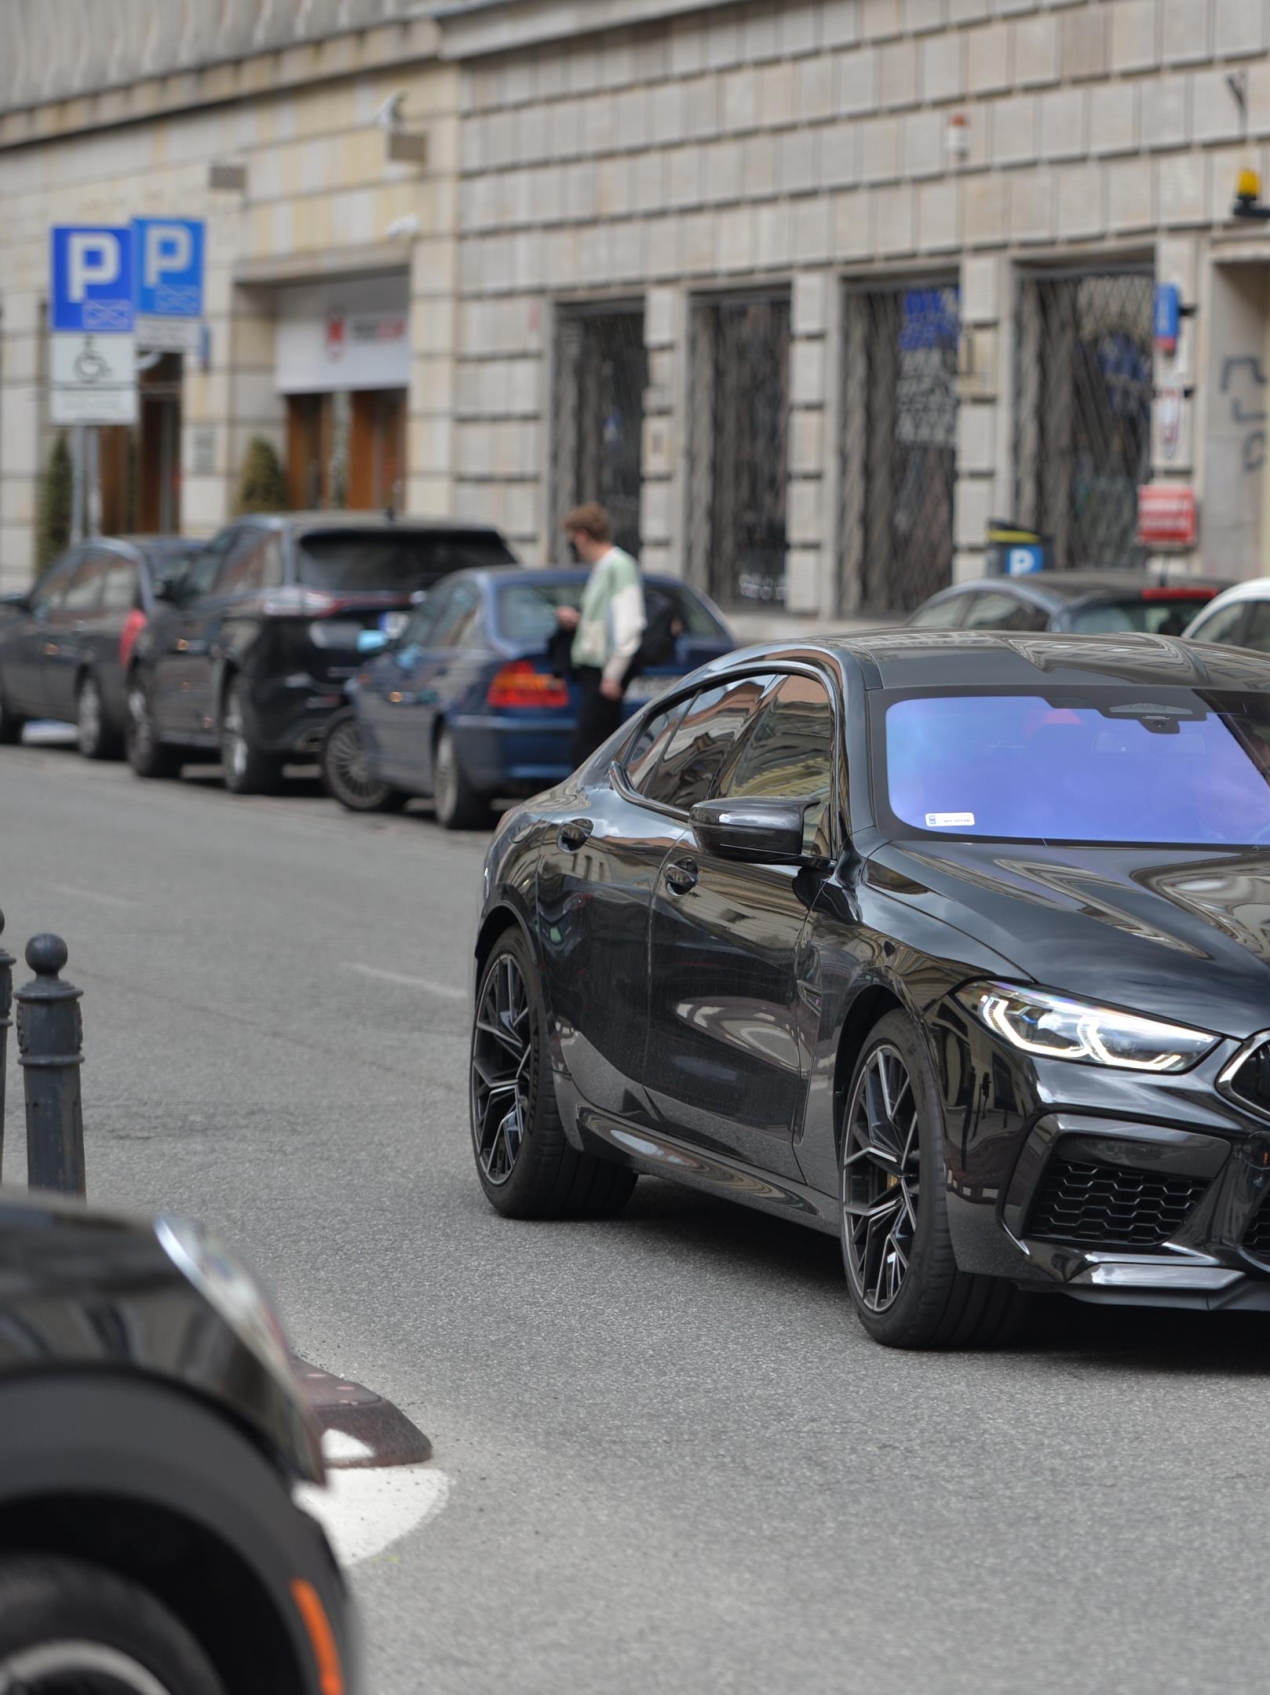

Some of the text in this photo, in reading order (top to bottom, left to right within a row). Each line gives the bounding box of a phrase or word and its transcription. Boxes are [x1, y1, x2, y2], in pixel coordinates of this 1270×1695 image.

[68, 231, 121, 303] P
[145, 225, 193, 288] P
[1010, 549, 1034, 577] P
